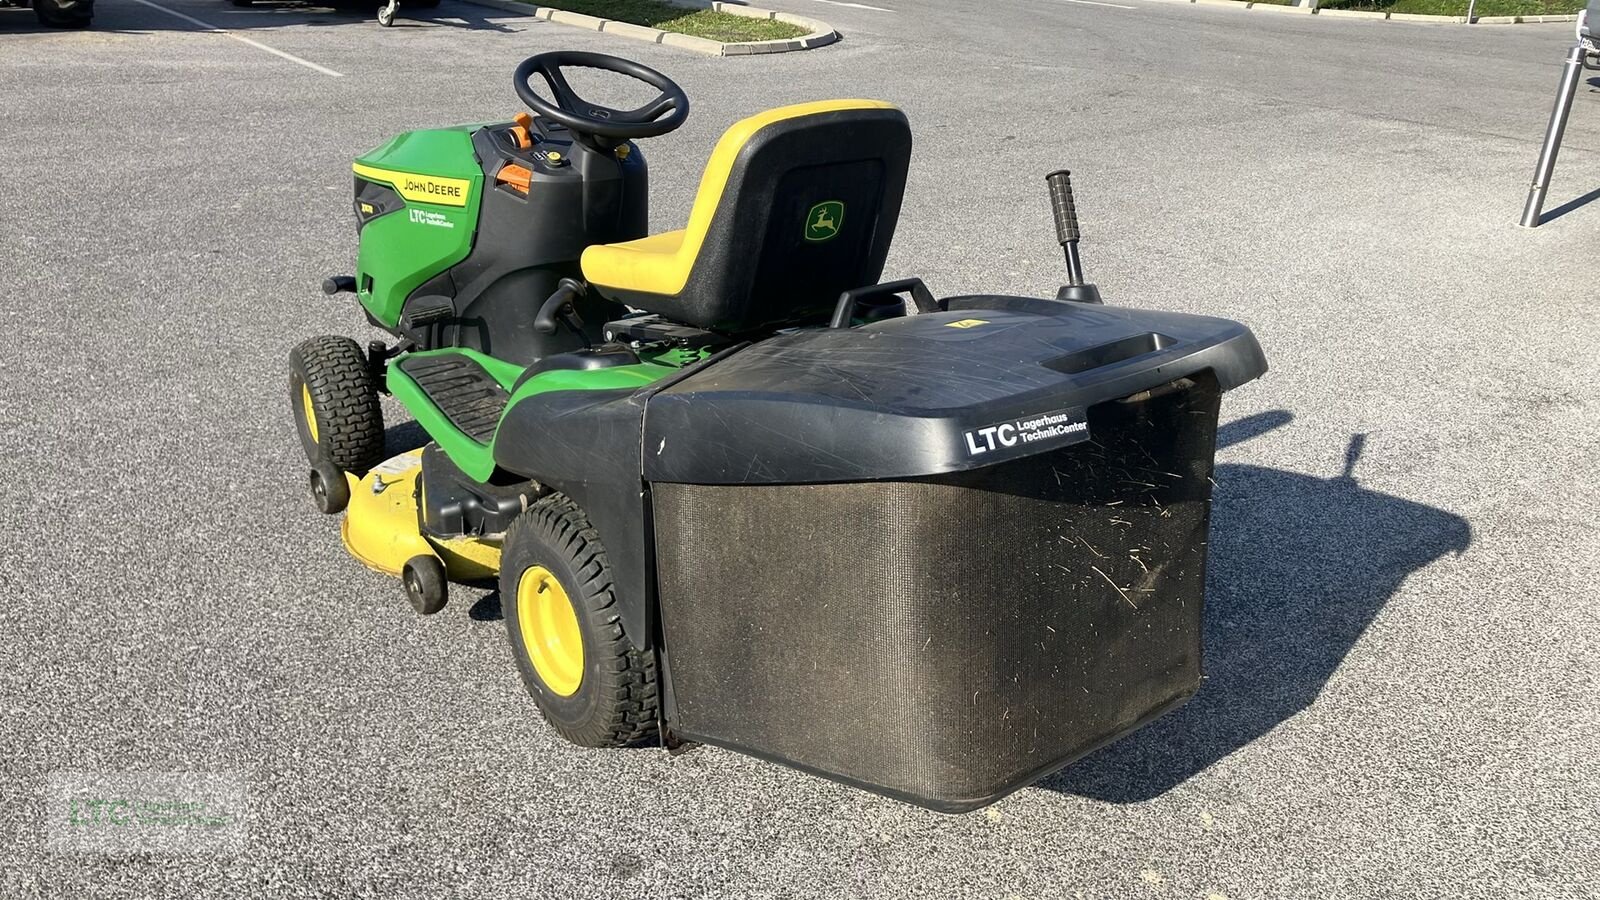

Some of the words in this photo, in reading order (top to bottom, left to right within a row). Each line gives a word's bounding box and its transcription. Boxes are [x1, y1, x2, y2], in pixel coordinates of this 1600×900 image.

[404, 178, 425, 193] JOHN
[428, 182, 461, 197] DEERE
[409, 209, 426, 223] LTC
[1017, 413, 1067, 431] Lagerhaus
[965, 423, 1017, 455] LTC
[1019, 421, 1088, 443] TechnikCenter
